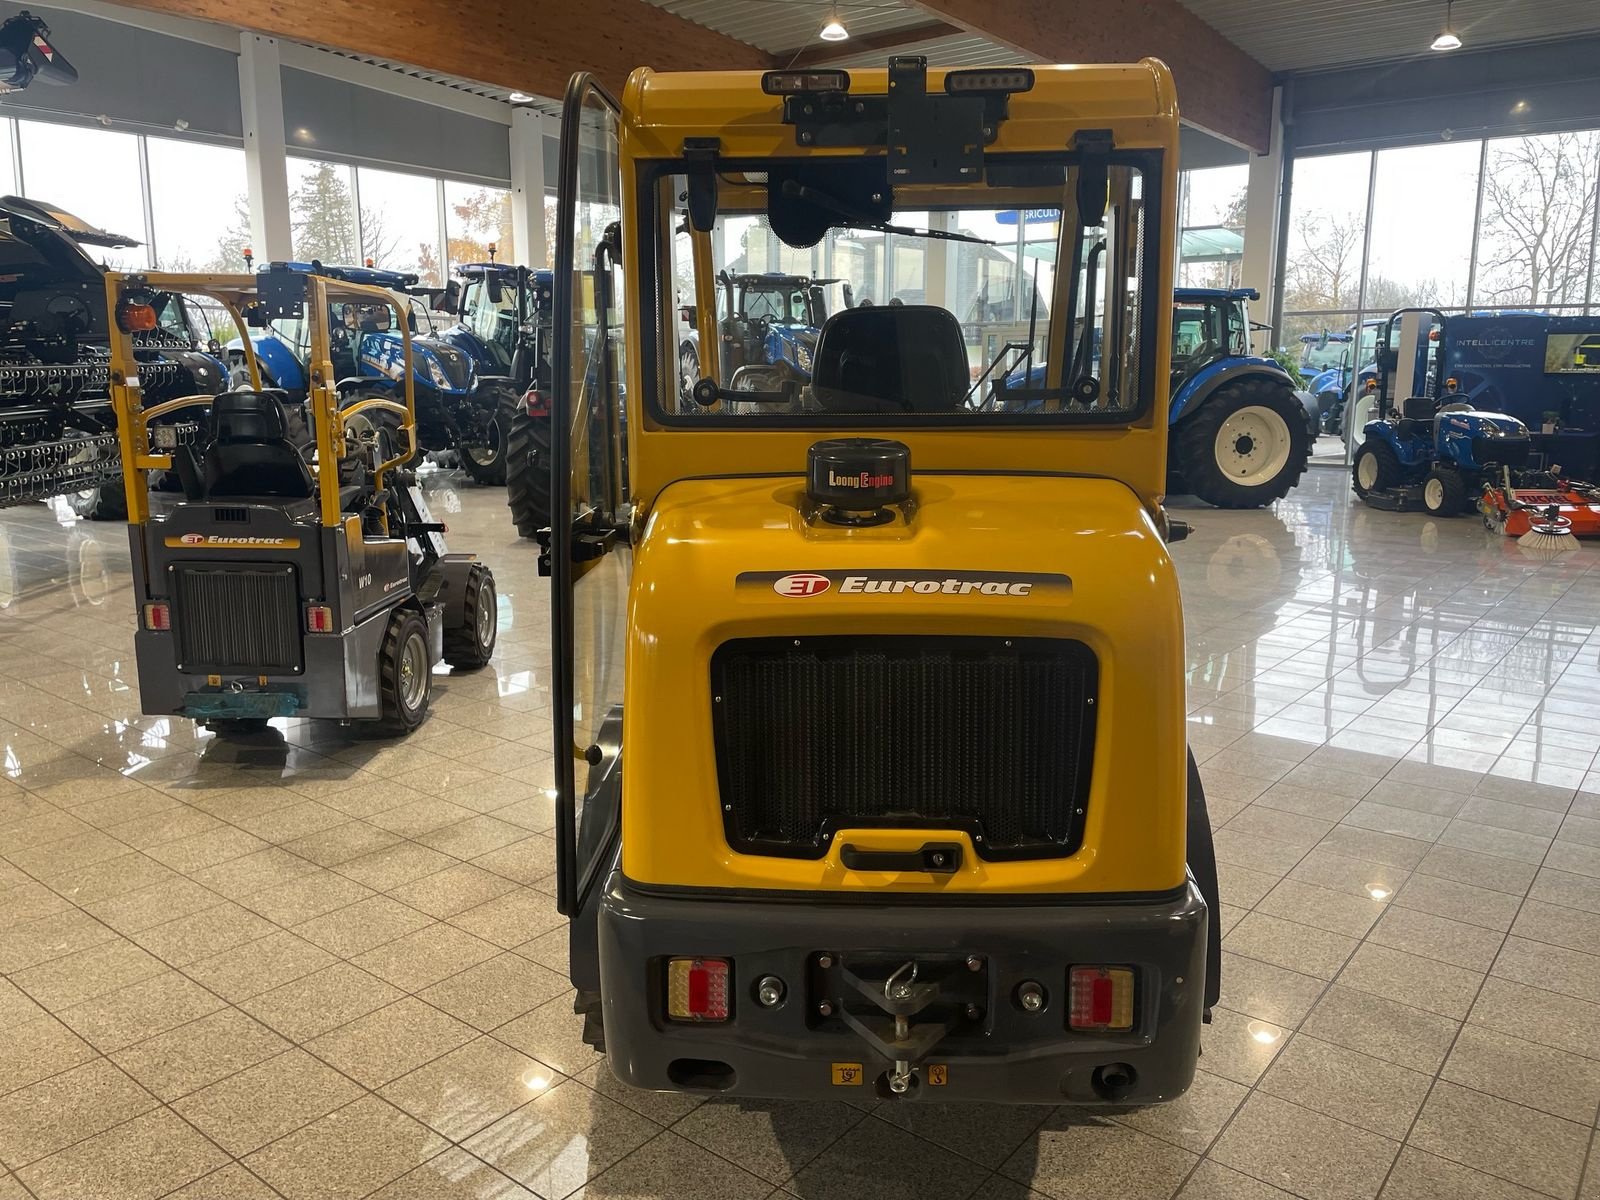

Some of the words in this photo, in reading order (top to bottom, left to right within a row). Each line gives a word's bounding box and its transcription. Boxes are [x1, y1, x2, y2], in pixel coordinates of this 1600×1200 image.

[1456, 339, 1536, 347] INTELLICENTRE
[207, 535, 284, 545] Eurotrac
[358, 572, 372, 590] W10
[838, 575, 1034, 597] Eurotrac
